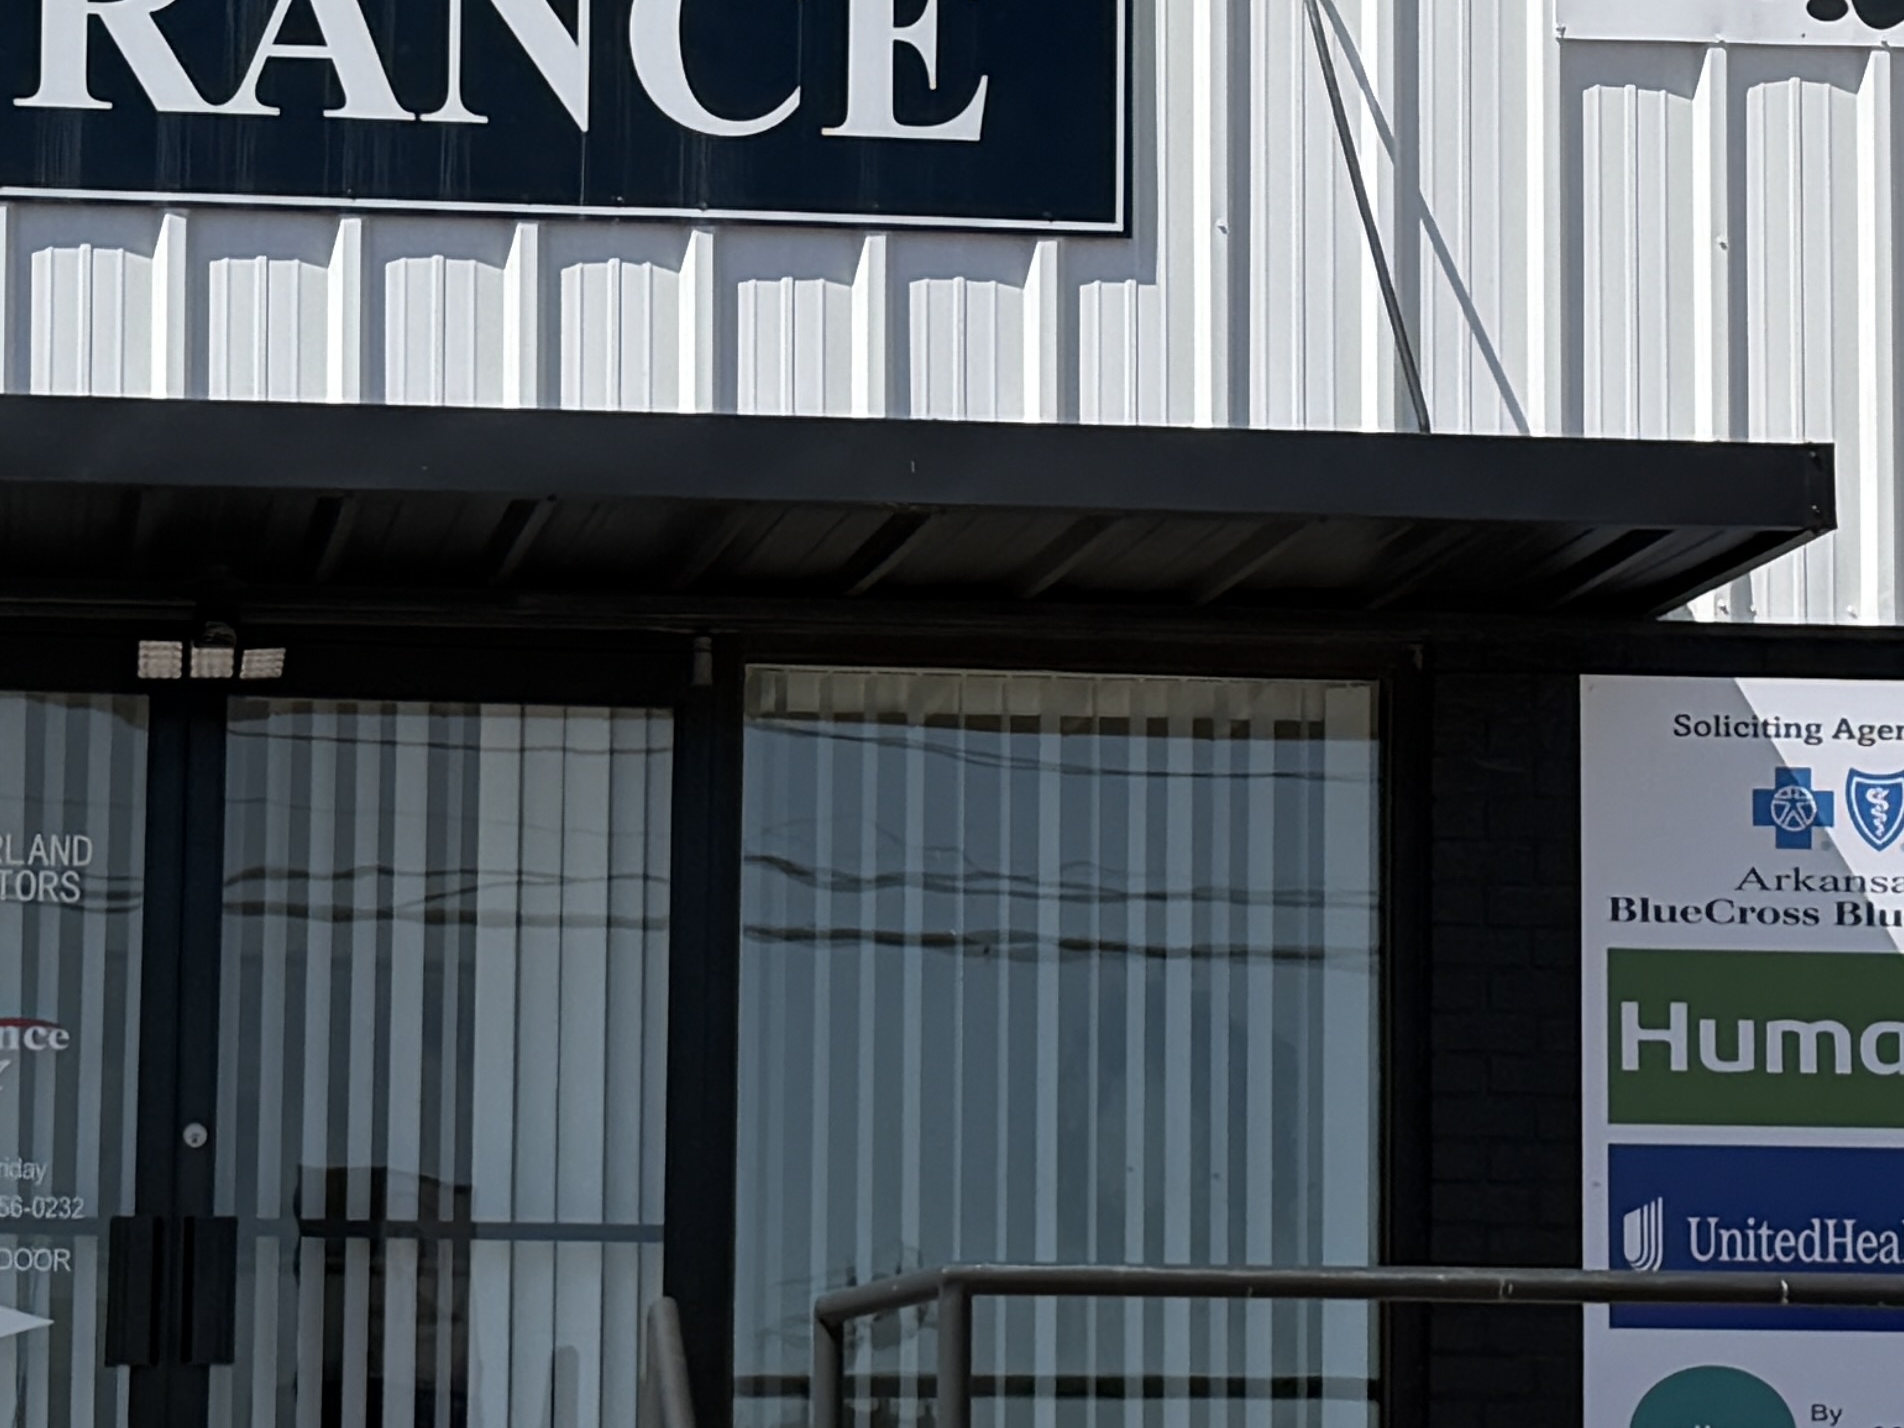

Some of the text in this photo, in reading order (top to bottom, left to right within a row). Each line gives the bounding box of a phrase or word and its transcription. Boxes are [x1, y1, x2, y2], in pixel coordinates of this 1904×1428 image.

[1673, 714, 1823, 745] Soliciting
[1608, 897, 1820, 926] BlueCross
[1810, 1403, 1843, 1427] By
